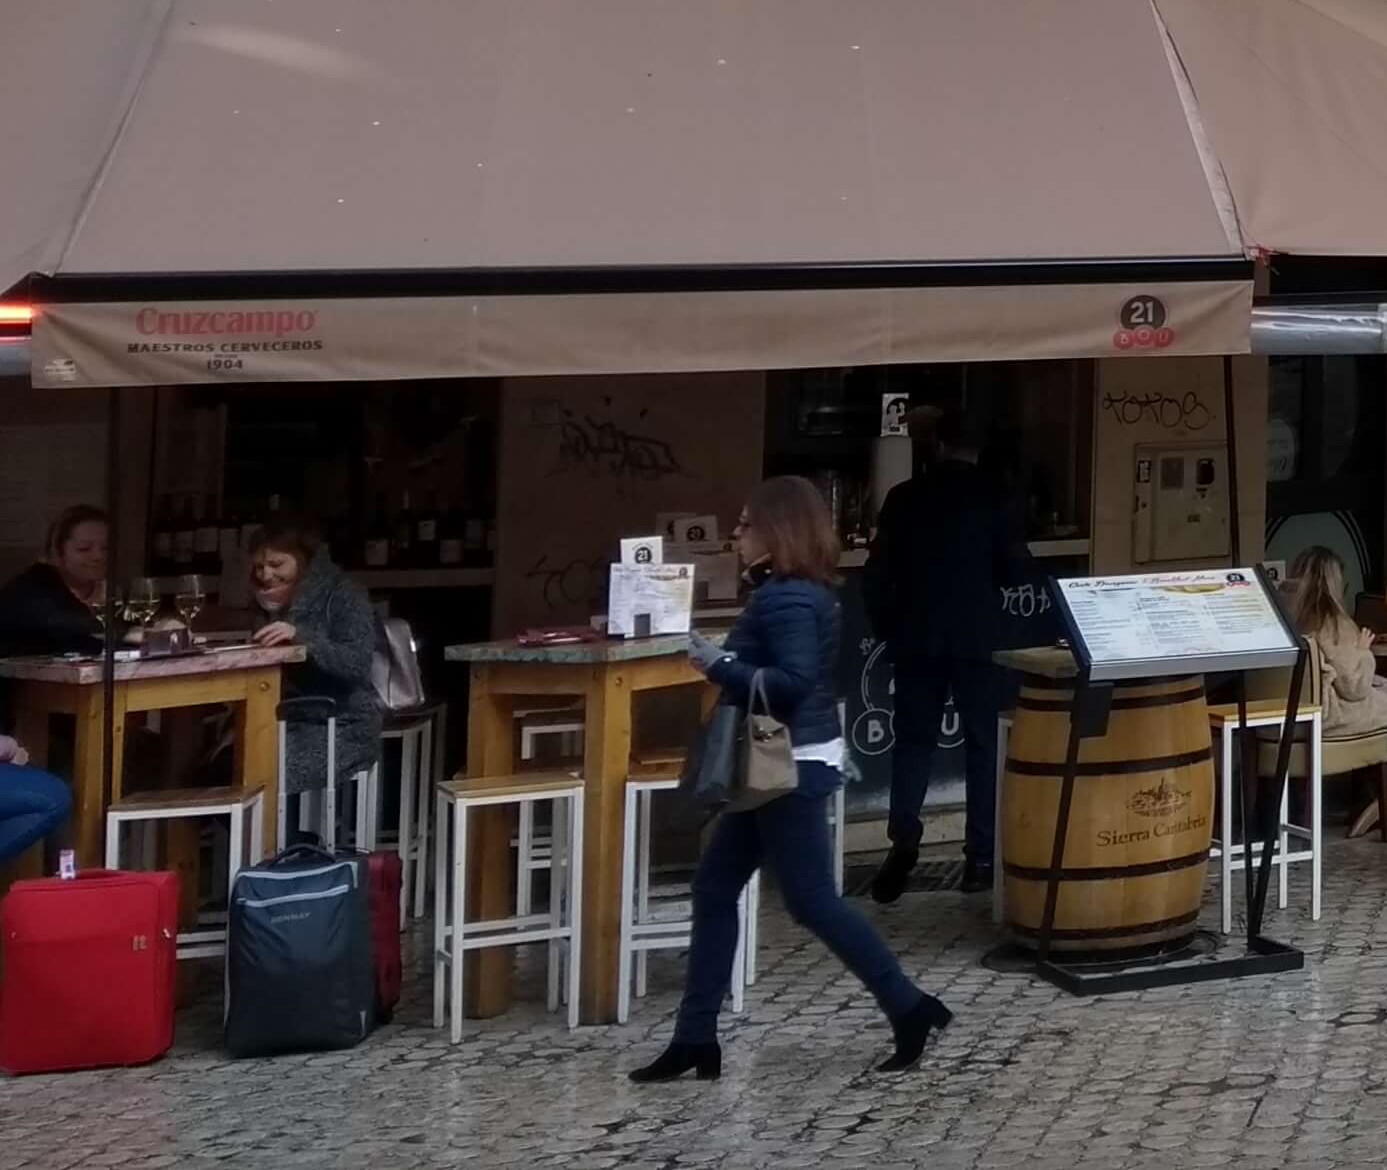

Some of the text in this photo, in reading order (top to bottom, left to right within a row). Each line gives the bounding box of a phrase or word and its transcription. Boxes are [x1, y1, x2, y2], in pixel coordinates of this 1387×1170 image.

[1130, 301, 1154, 324] 21
[135, 307, 316, 338] Cruzcampo
[127, 340, 323, 354] MAESTROS CERVECEROS
[206, 358, 243, 371] 1904
[1096, 829, 1151, 847] Sierra
